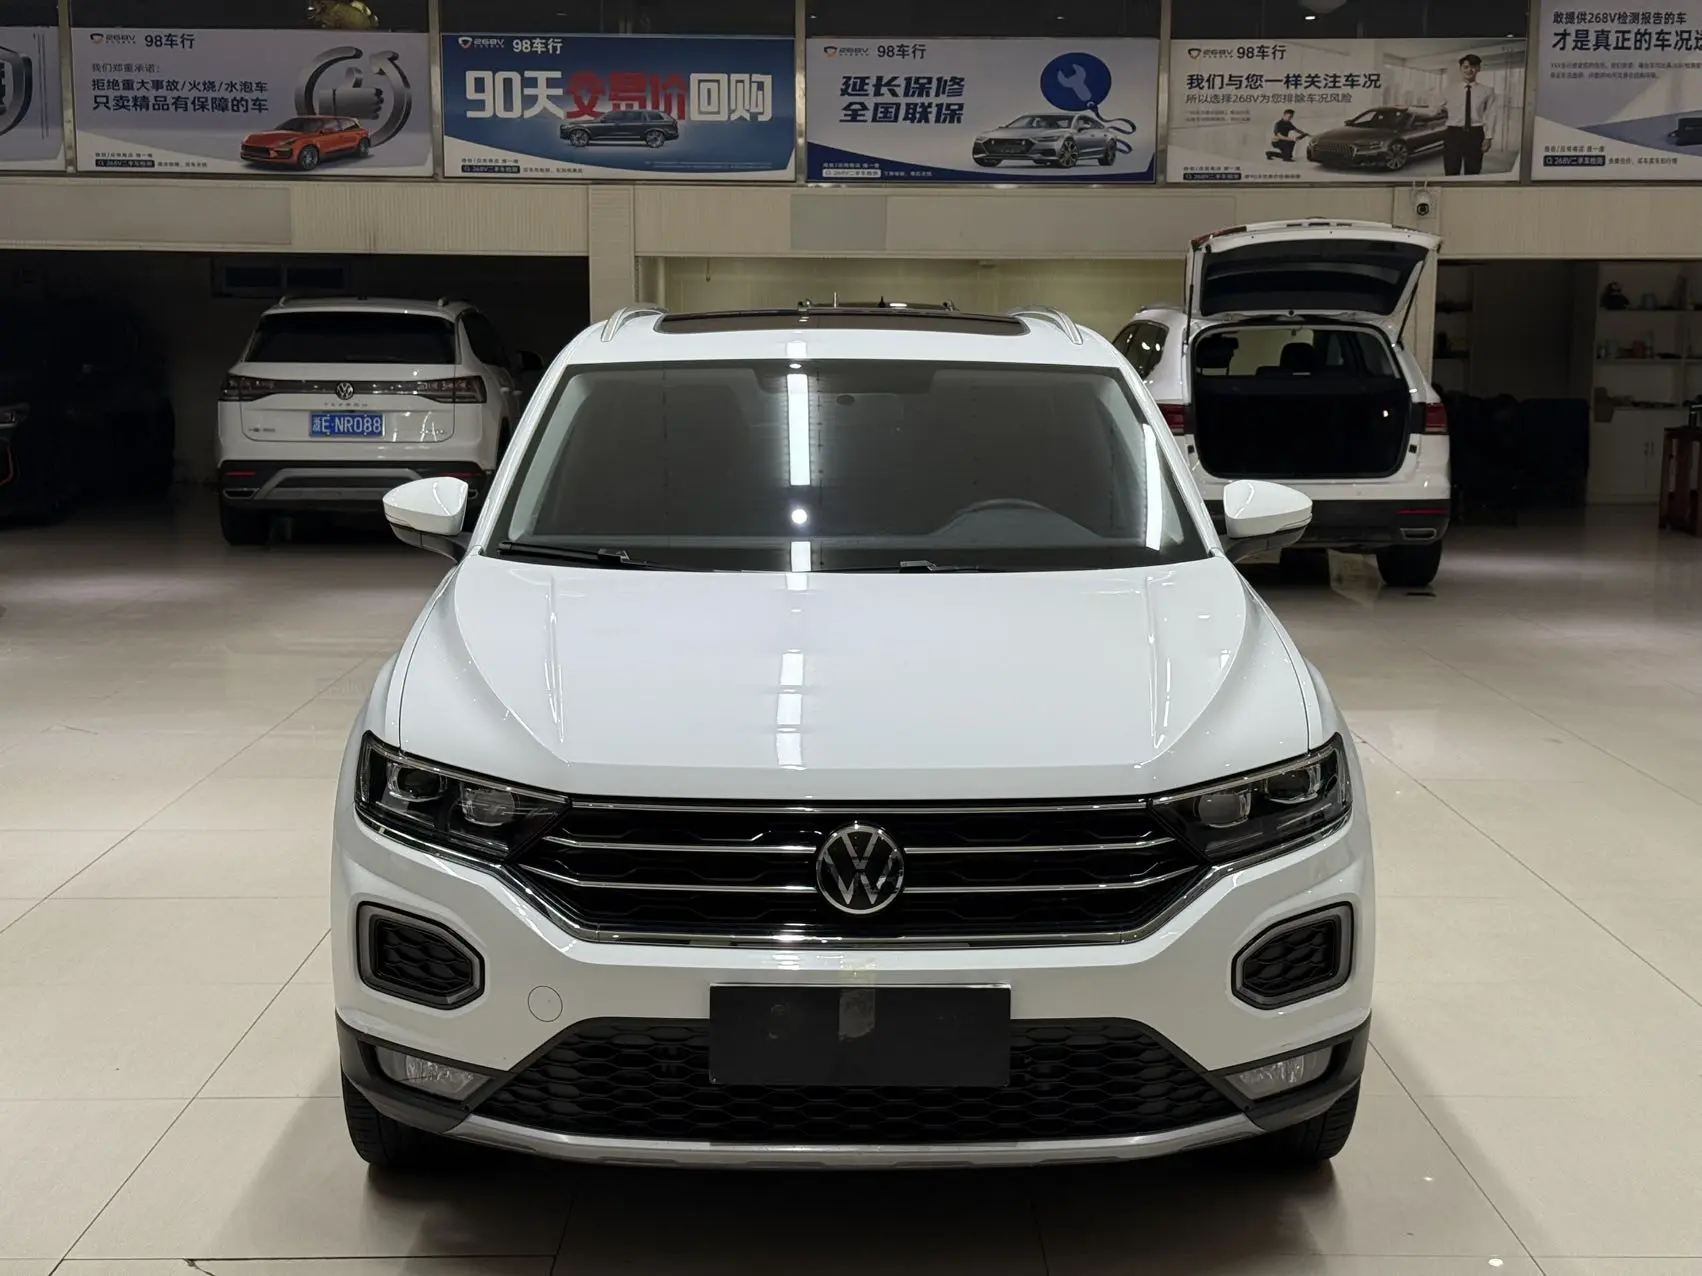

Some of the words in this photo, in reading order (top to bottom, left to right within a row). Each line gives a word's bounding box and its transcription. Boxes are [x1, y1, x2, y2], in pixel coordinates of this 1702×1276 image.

[1552, 11, 1688, 25] 敢提供268V检测报告的车
[144, 33, 195, 49] 98车行
[512, 38, 563, 54] 98车行
[877, 44, 927, 60] 98车行
[1237, 45, 1286, 60] 98车行
[91, 79, 269, 93] 拒绝重大事故/火烧/水泡车
[840, 76, 966, 98] 延长保修
[1186, 73, 1382, 90] 我们与您一样关注车况
[92, 95, 269, 113] 只卖精品有保障的车
[1185, 93, 1353, 104] 所以选择268V为您排除车况风险
[839, 102, 965, 124] 全国联保
